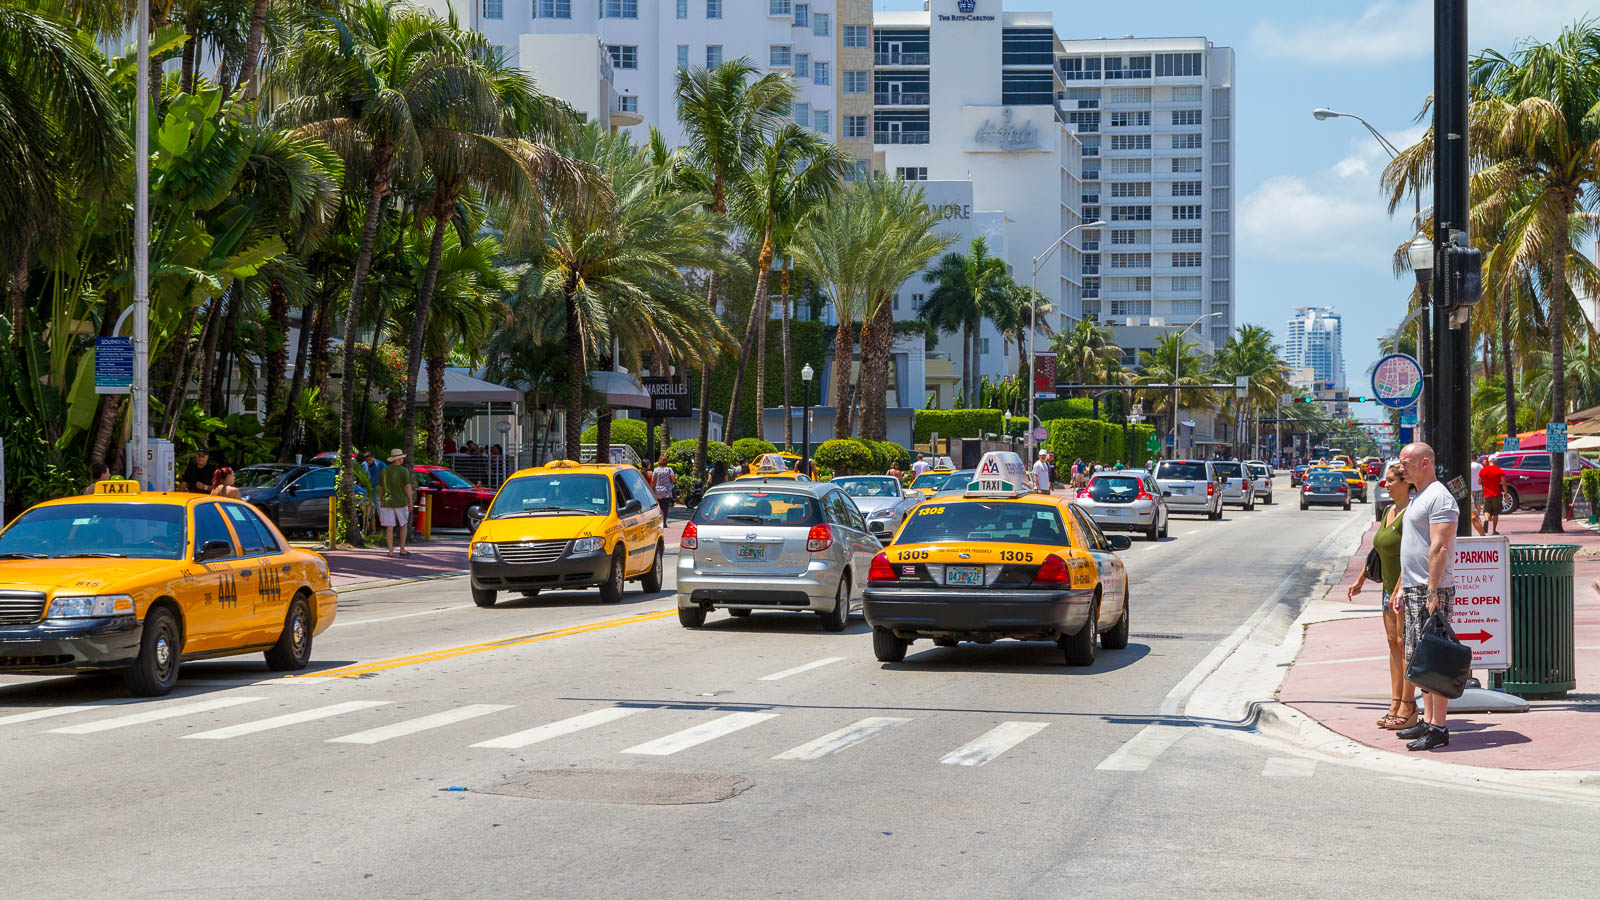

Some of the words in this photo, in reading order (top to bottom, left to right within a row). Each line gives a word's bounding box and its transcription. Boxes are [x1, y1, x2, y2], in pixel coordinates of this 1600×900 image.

[655, 399, 678, 410] HOTEL
[102, 484, 129, 493] TAXI
[981, 480, 1000, 490] TAXI
[918, 506, 946, 516] 1305
[897, 550, 929, 561] 1305
[999, 550, 1034, 562] 1305
[1460, 550, 1499, 563] PARKING
[218, 574, 237, 609] 444
[258, 567, 281, 602] 4444
[1453, 596, 1469, 605] RE
[1471, 596, 1500, 605] OPEN
